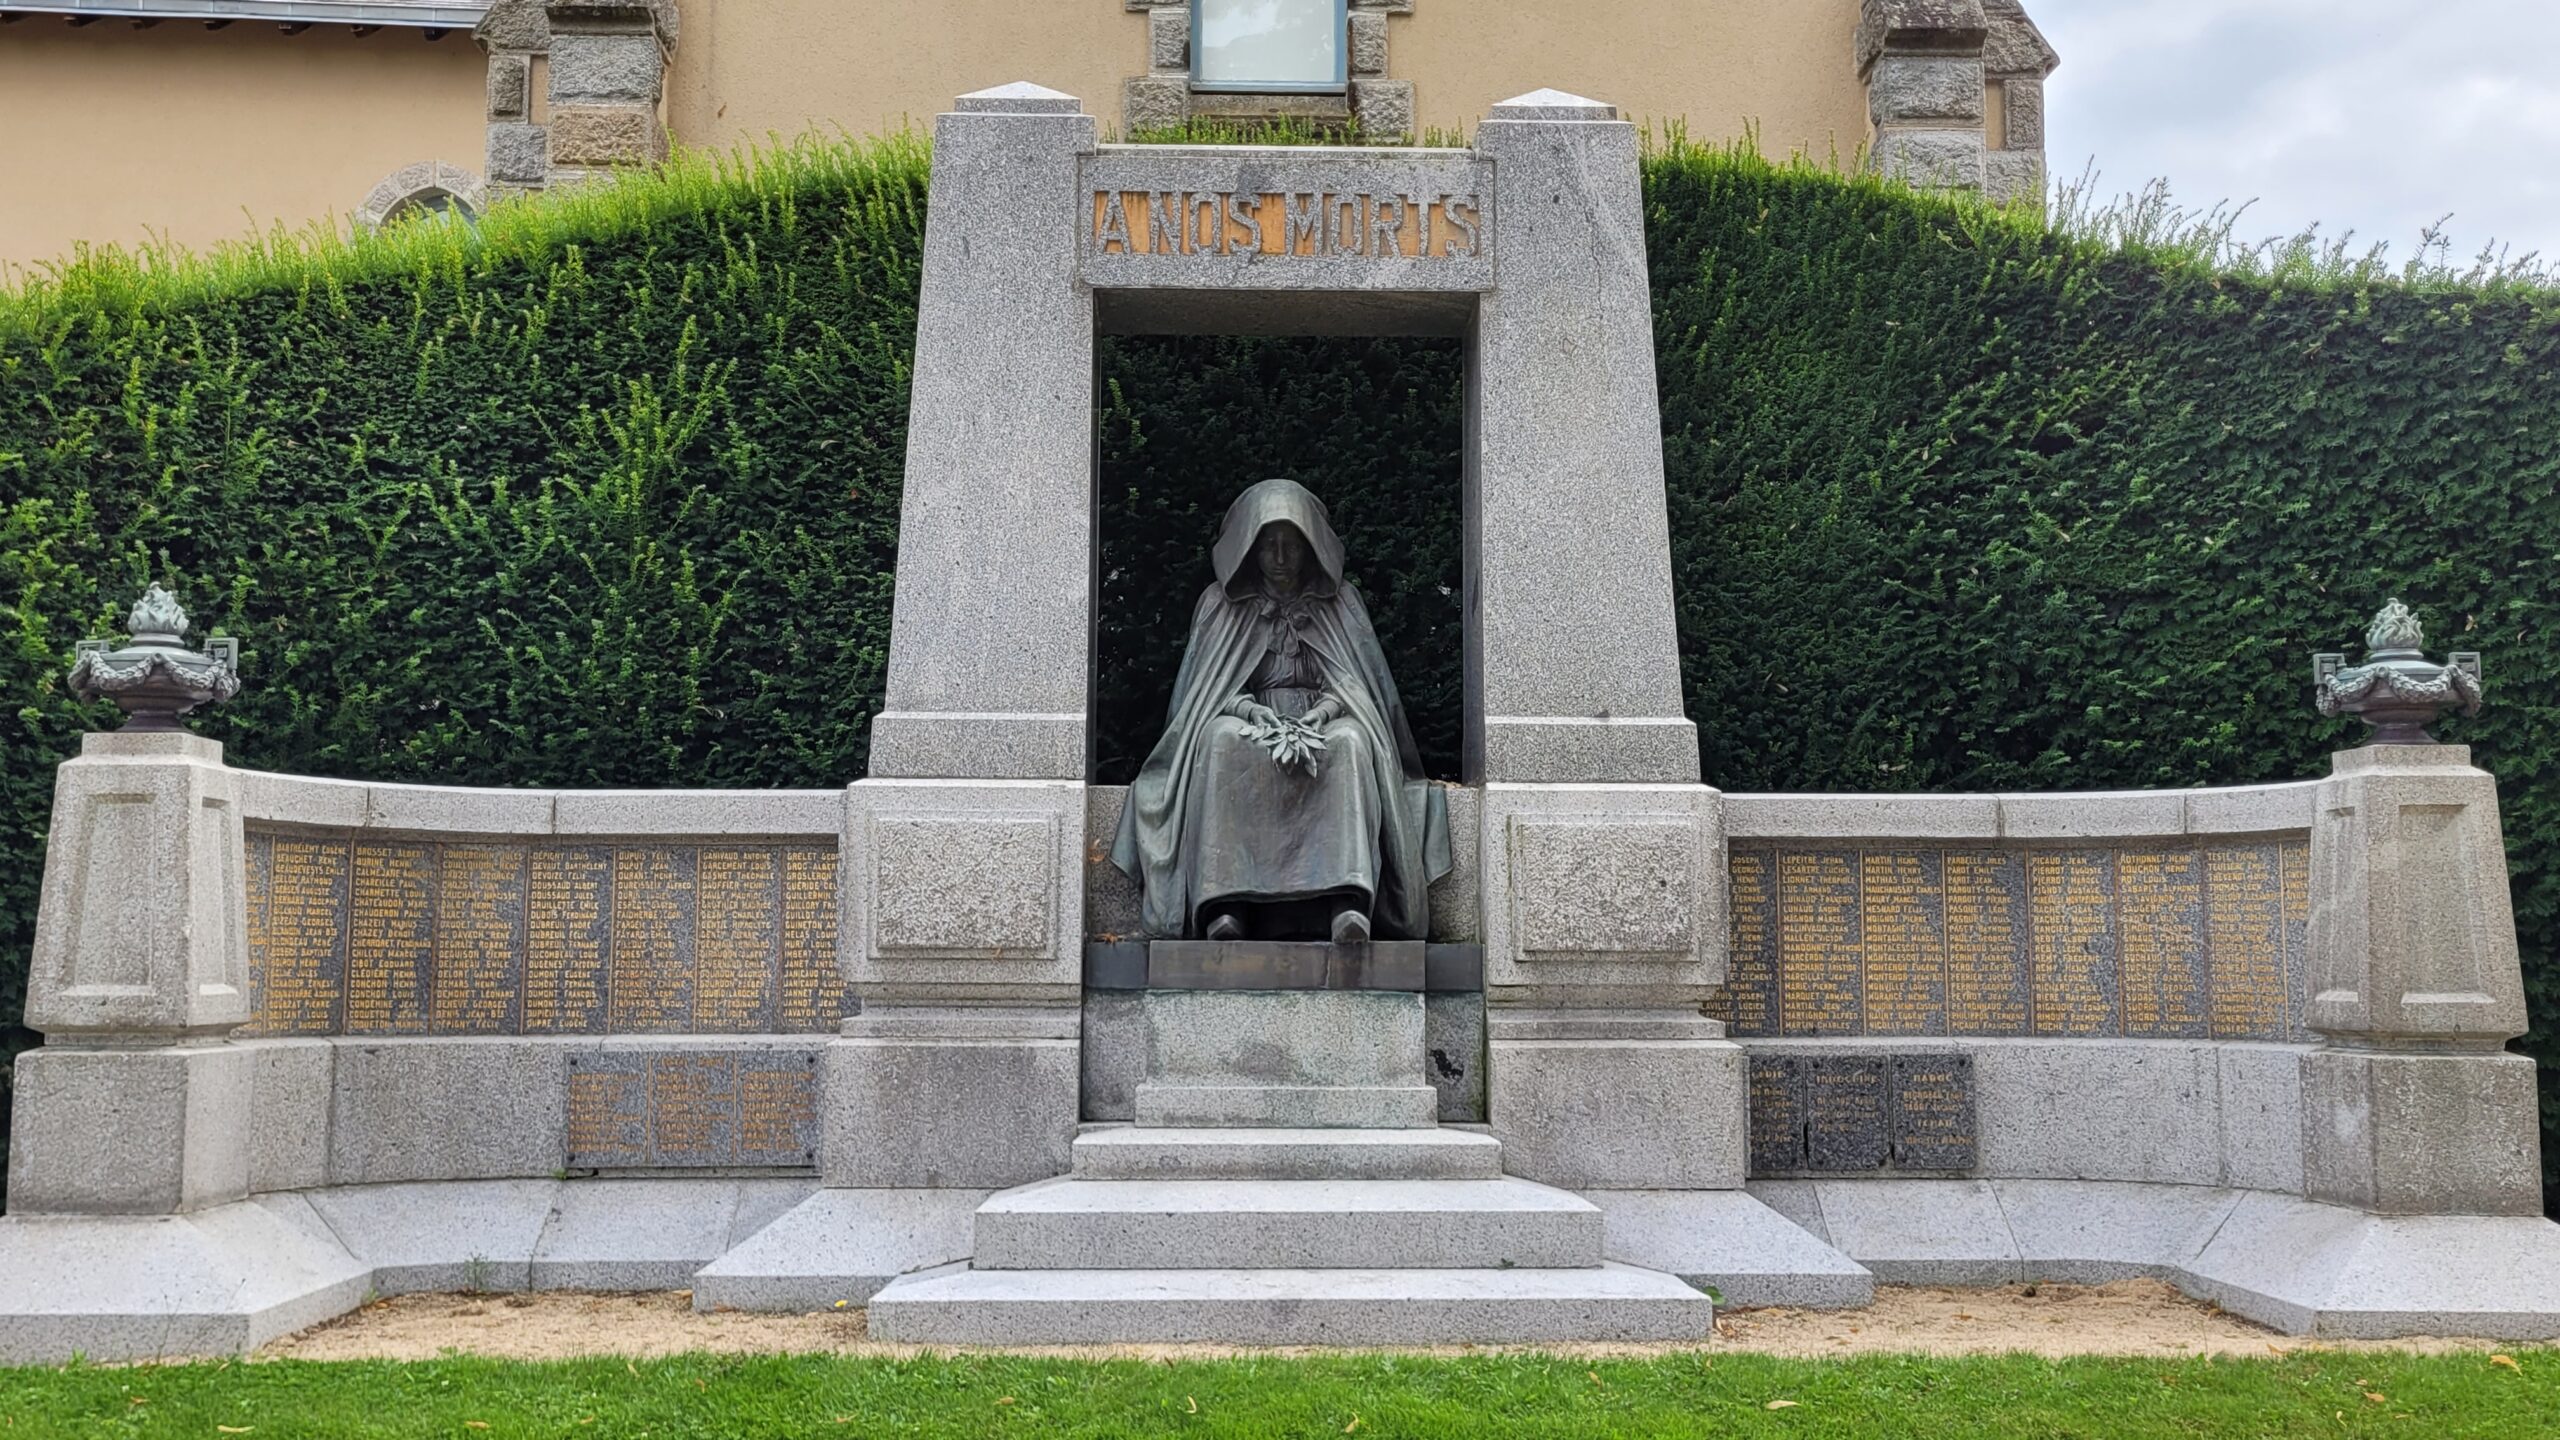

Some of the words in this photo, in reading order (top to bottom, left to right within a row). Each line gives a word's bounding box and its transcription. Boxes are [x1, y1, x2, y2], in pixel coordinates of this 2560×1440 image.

[1098, 192, 1132, 255] A
[1149, 192, 1262, 255] NOS
[1285, 193, 1480, 257] MORTS
